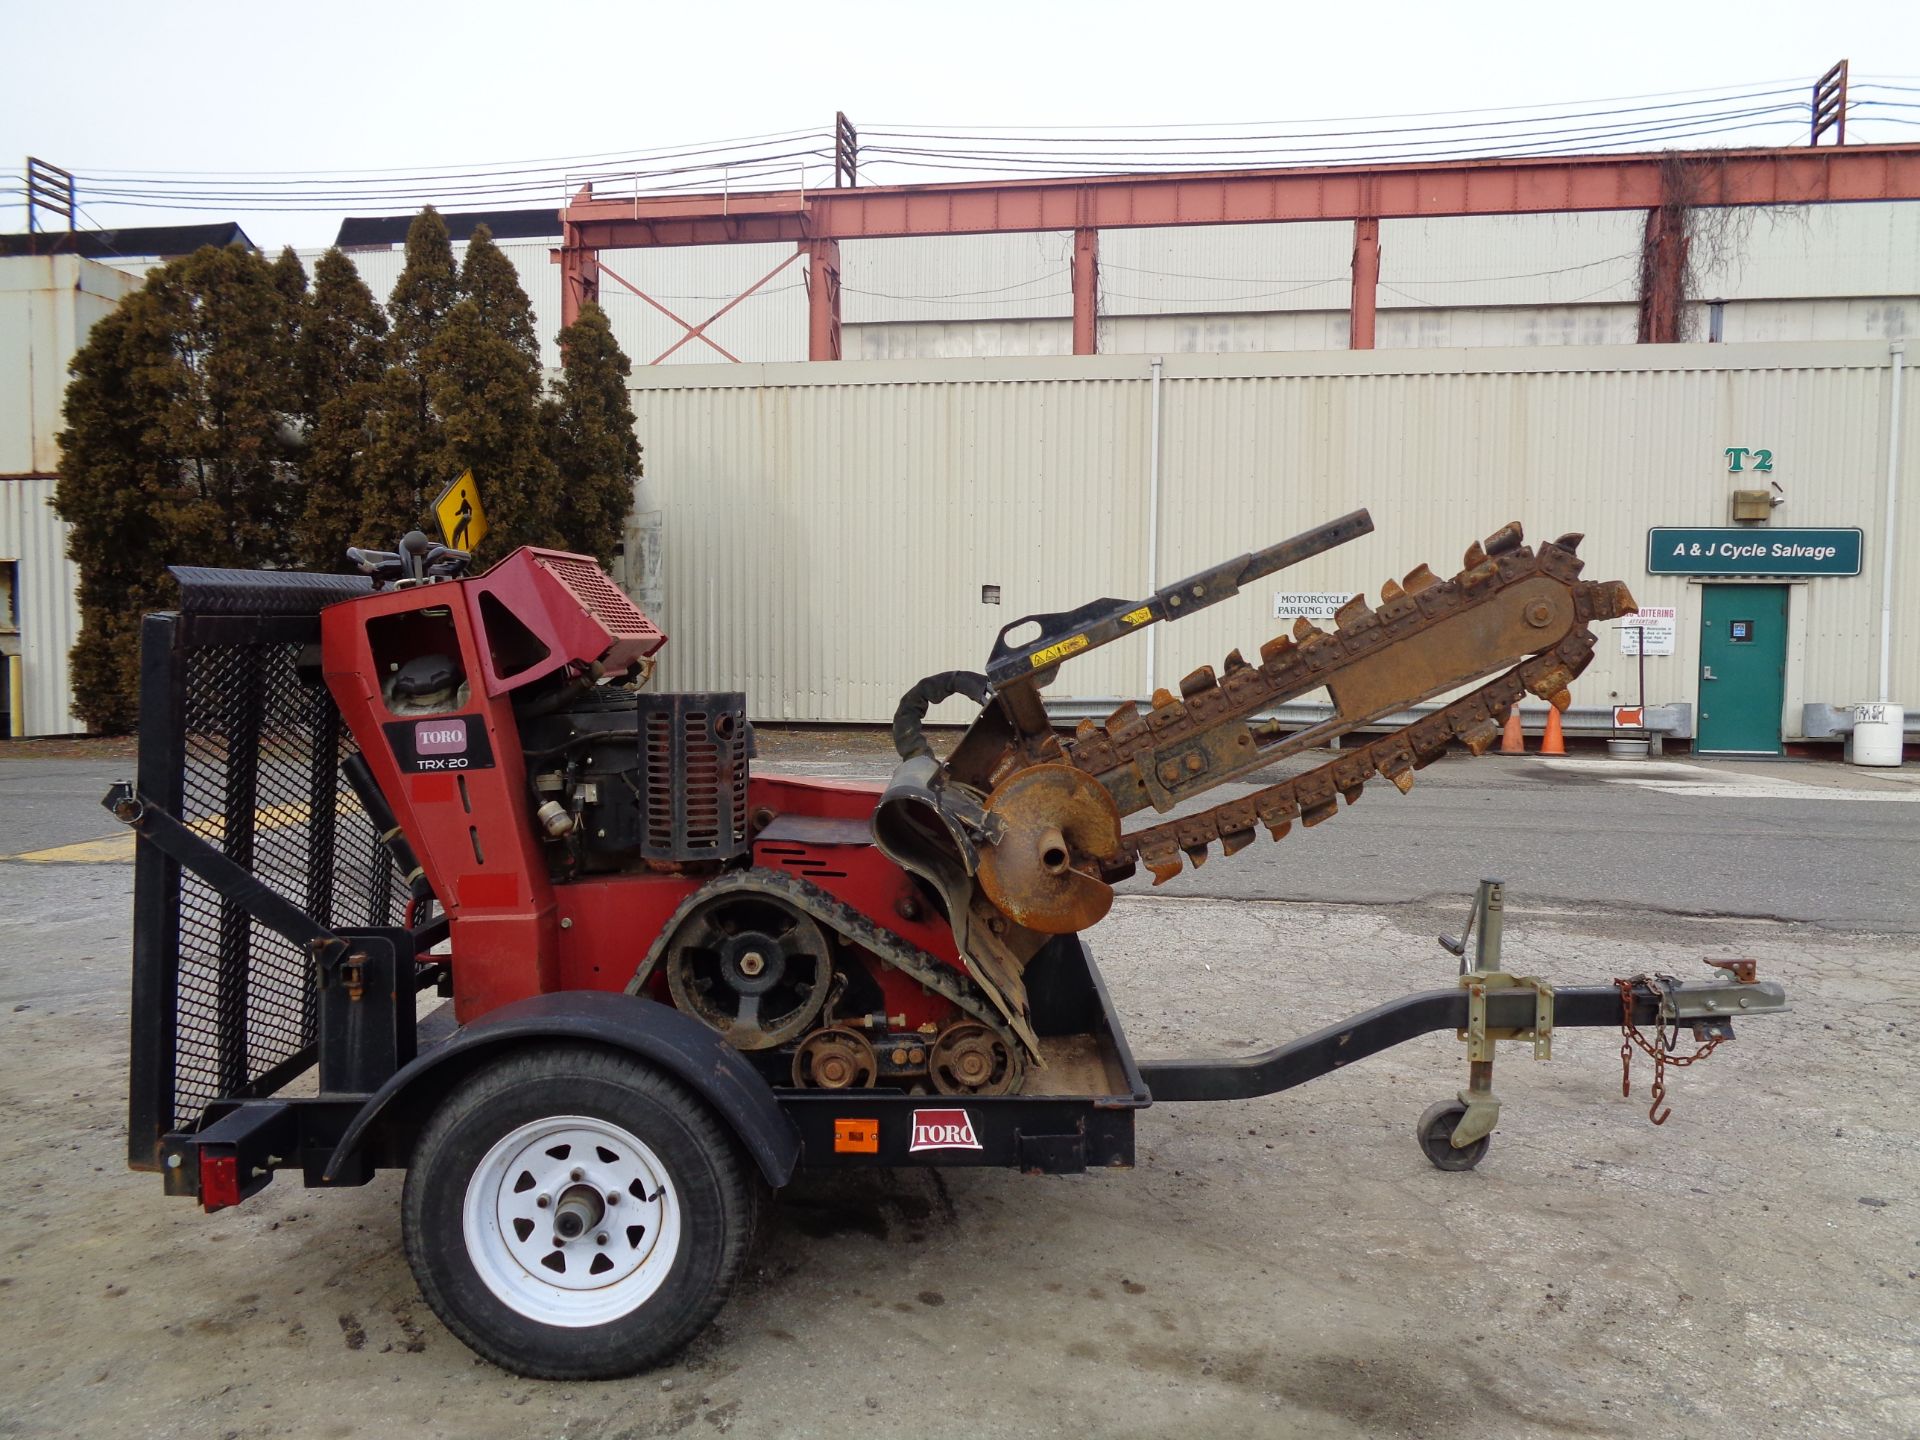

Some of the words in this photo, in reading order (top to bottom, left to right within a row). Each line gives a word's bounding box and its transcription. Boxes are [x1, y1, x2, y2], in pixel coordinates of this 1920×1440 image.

[1673, 543, 1685, 556] A
[1690, 543, 1701, 556] &
[1705, 543, 1716, 556] J
[1720, 543, 1767, 559] Cycle
[1771, 543, 1836, 560] Salvage
[1278, 606, 1322, 615] PARKING
[420, 730, 464, 745] TORO
